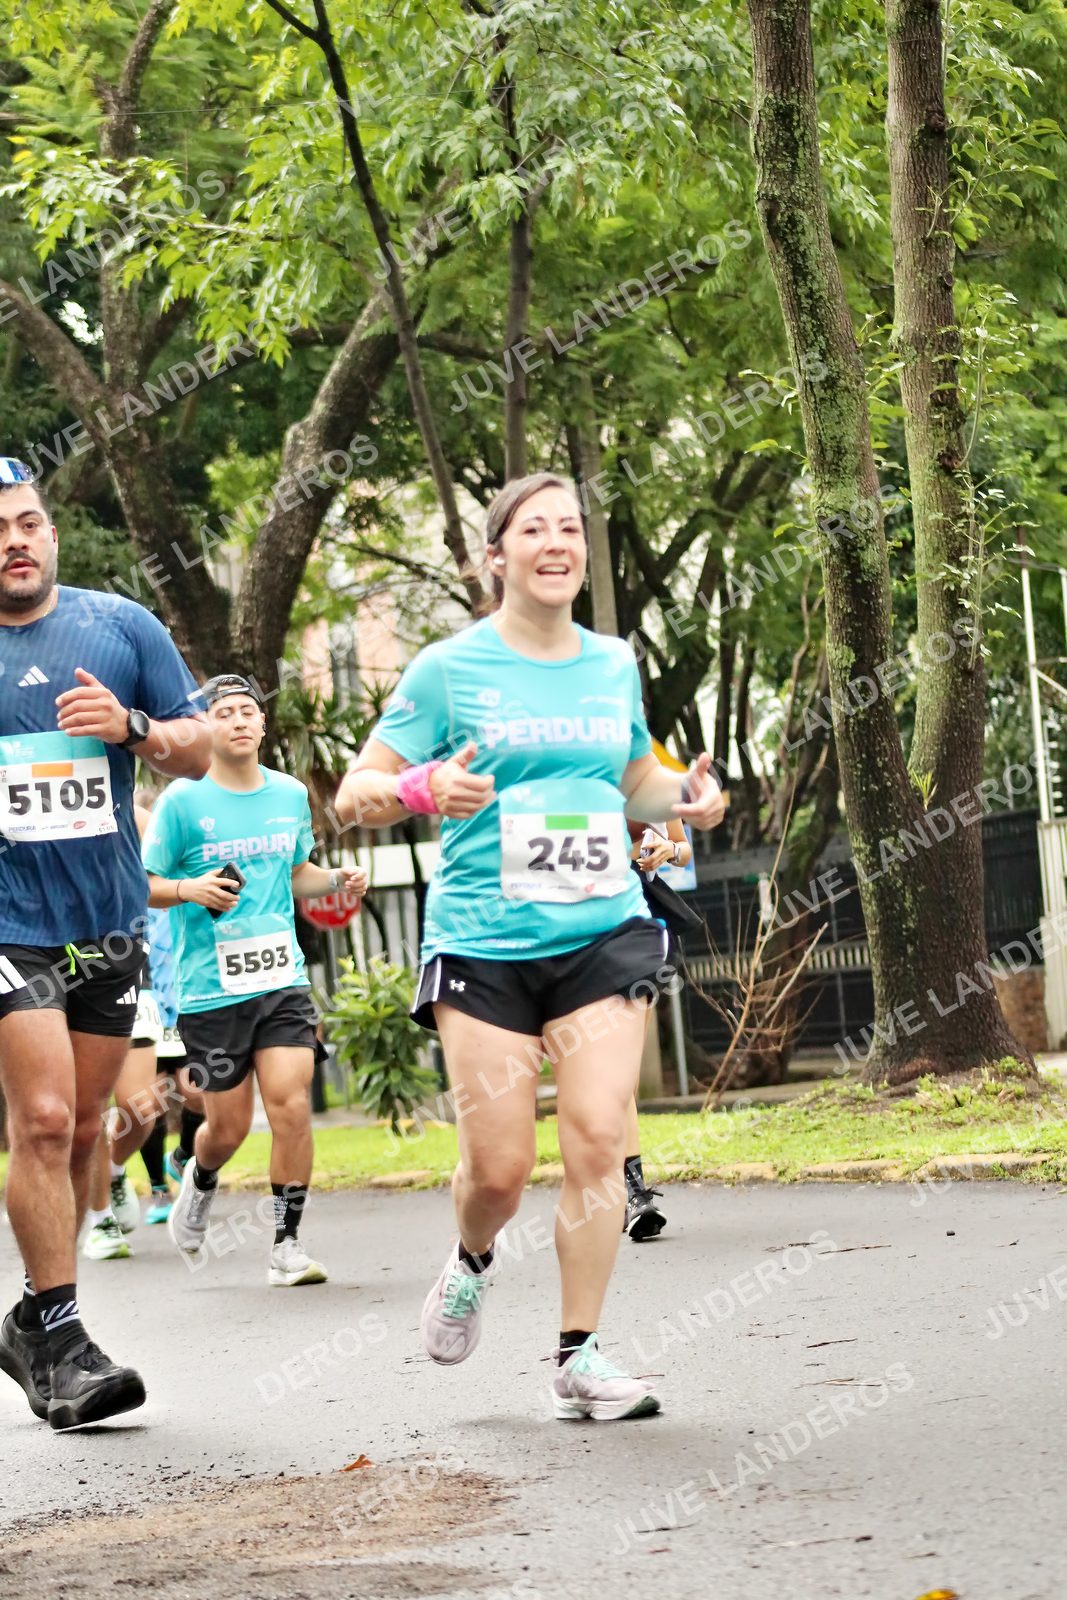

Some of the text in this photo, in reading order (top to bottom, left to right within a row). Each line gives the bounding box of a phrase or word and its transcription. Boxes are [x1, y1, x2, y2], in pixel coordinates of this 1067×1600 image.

[8, 776, 107, 816] 5105
[527, 835, 610, 872] 245
[225, 944, 290, 976] 5593
